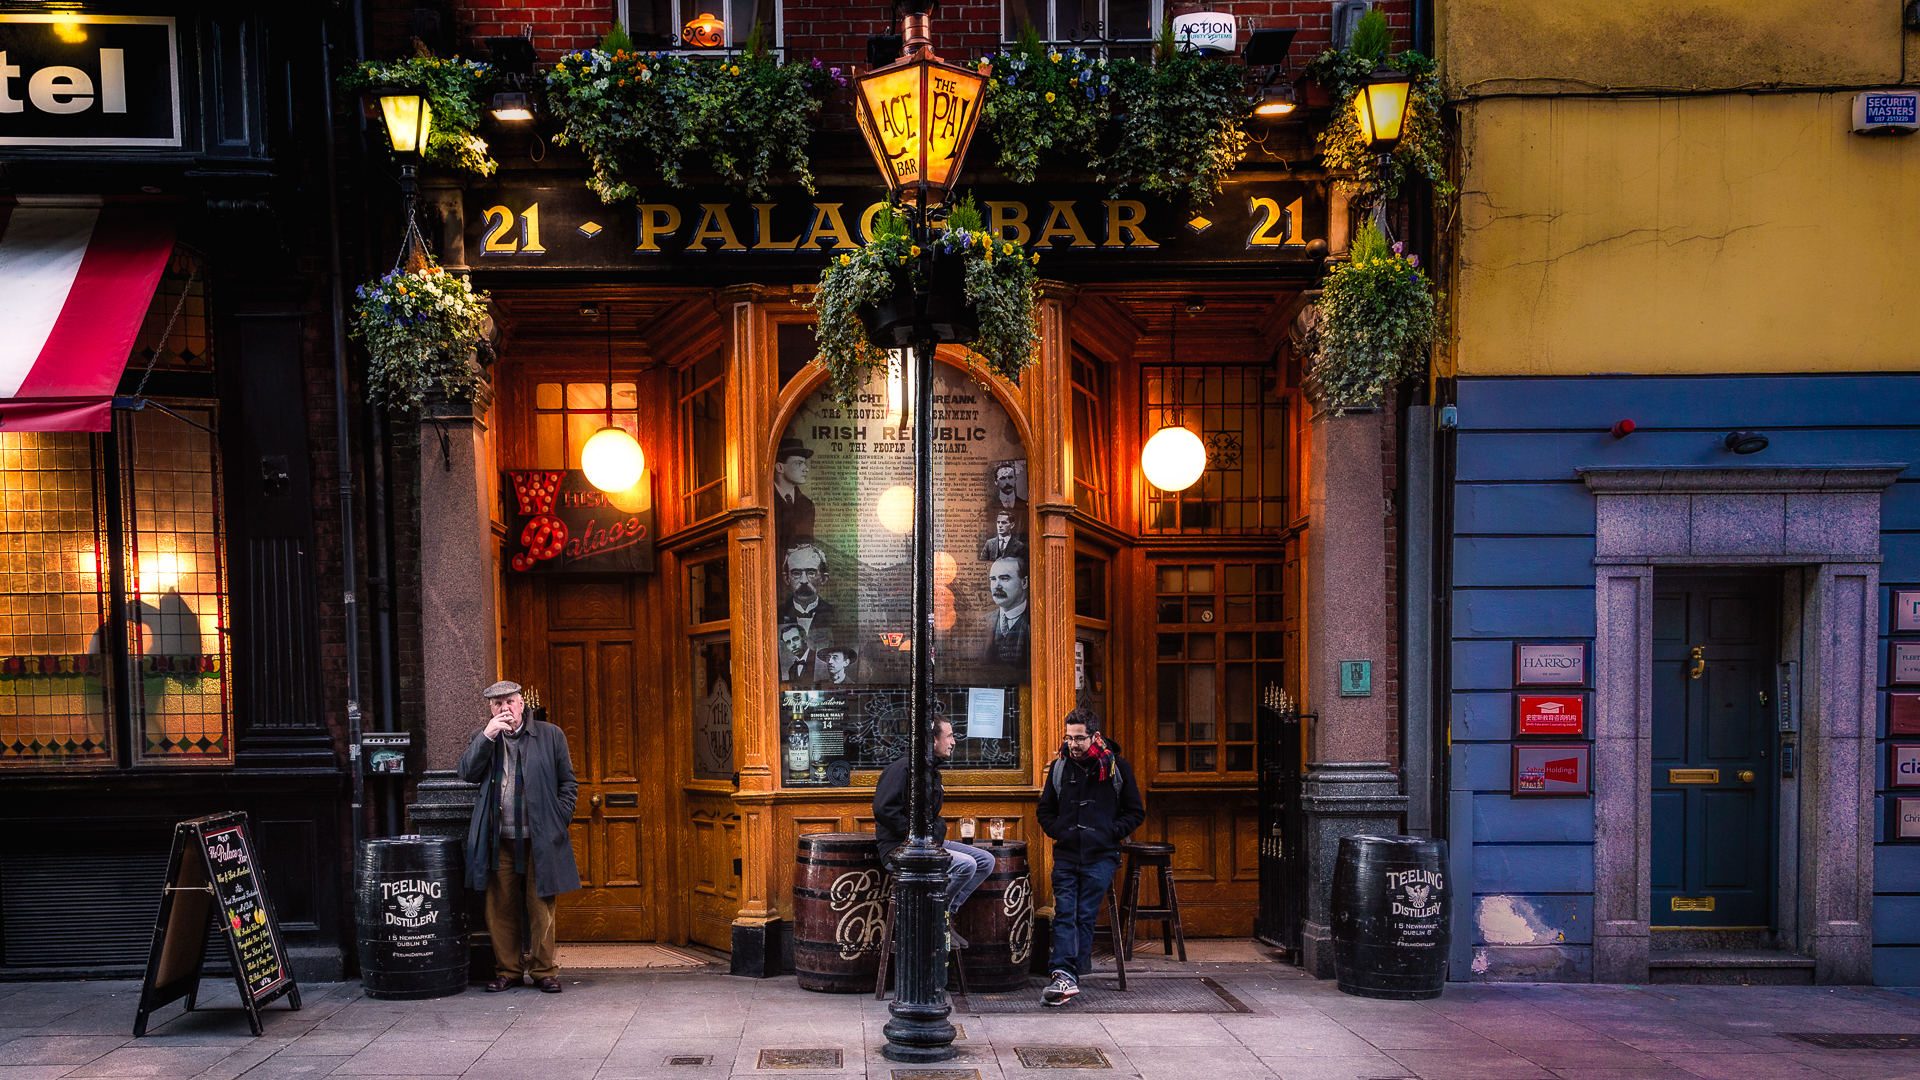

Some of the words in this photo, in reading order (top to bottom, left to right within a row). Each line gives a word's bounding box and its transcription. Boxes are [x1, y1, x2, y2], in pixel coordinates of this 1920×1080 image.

[1180, 23, 1232, 34] ACTION
[934, 76, 957, 94] THE
[1868, 97, 1915, 107] SECURITY
[881, 92, 917, 141] ACE
[1868, 107, 1914, 116] MASTERS
[896, 158, 917, 177] BAR
[480, 202, 547, 257] 21
[985, 198, 1160, 252] BAR
[1246, 195, 1307, 251] 21
[821, 393, 883, 403] POACHT
[821, 409, 841, 419] THE
[812, 426, 867, 440] IRISH
[882, 426, 987, 441] REUBLIC
[831, 443, 843, 452] TO
[849, 443, 867, 453] THE
[873, 443, 906, 453] PEOPLE
[512, 515, 647, 572] Palace
[1523, 658, 1581, 668] HARROP
[712, 703, 729, 725] THE
[822, 720, 833, 730] 14
[1546, 766, 1576, 775] Holdings
[208, 845, 217, 860] The
[216, 842, 238, 863] Palace
[1386, 869, 1443, 890] TEELING
[380, 879, 441, 900] TEELING
[385, 910, 439, 928] DISTILLERY
[1392, 902, 1442, 918] DISTILLERY
